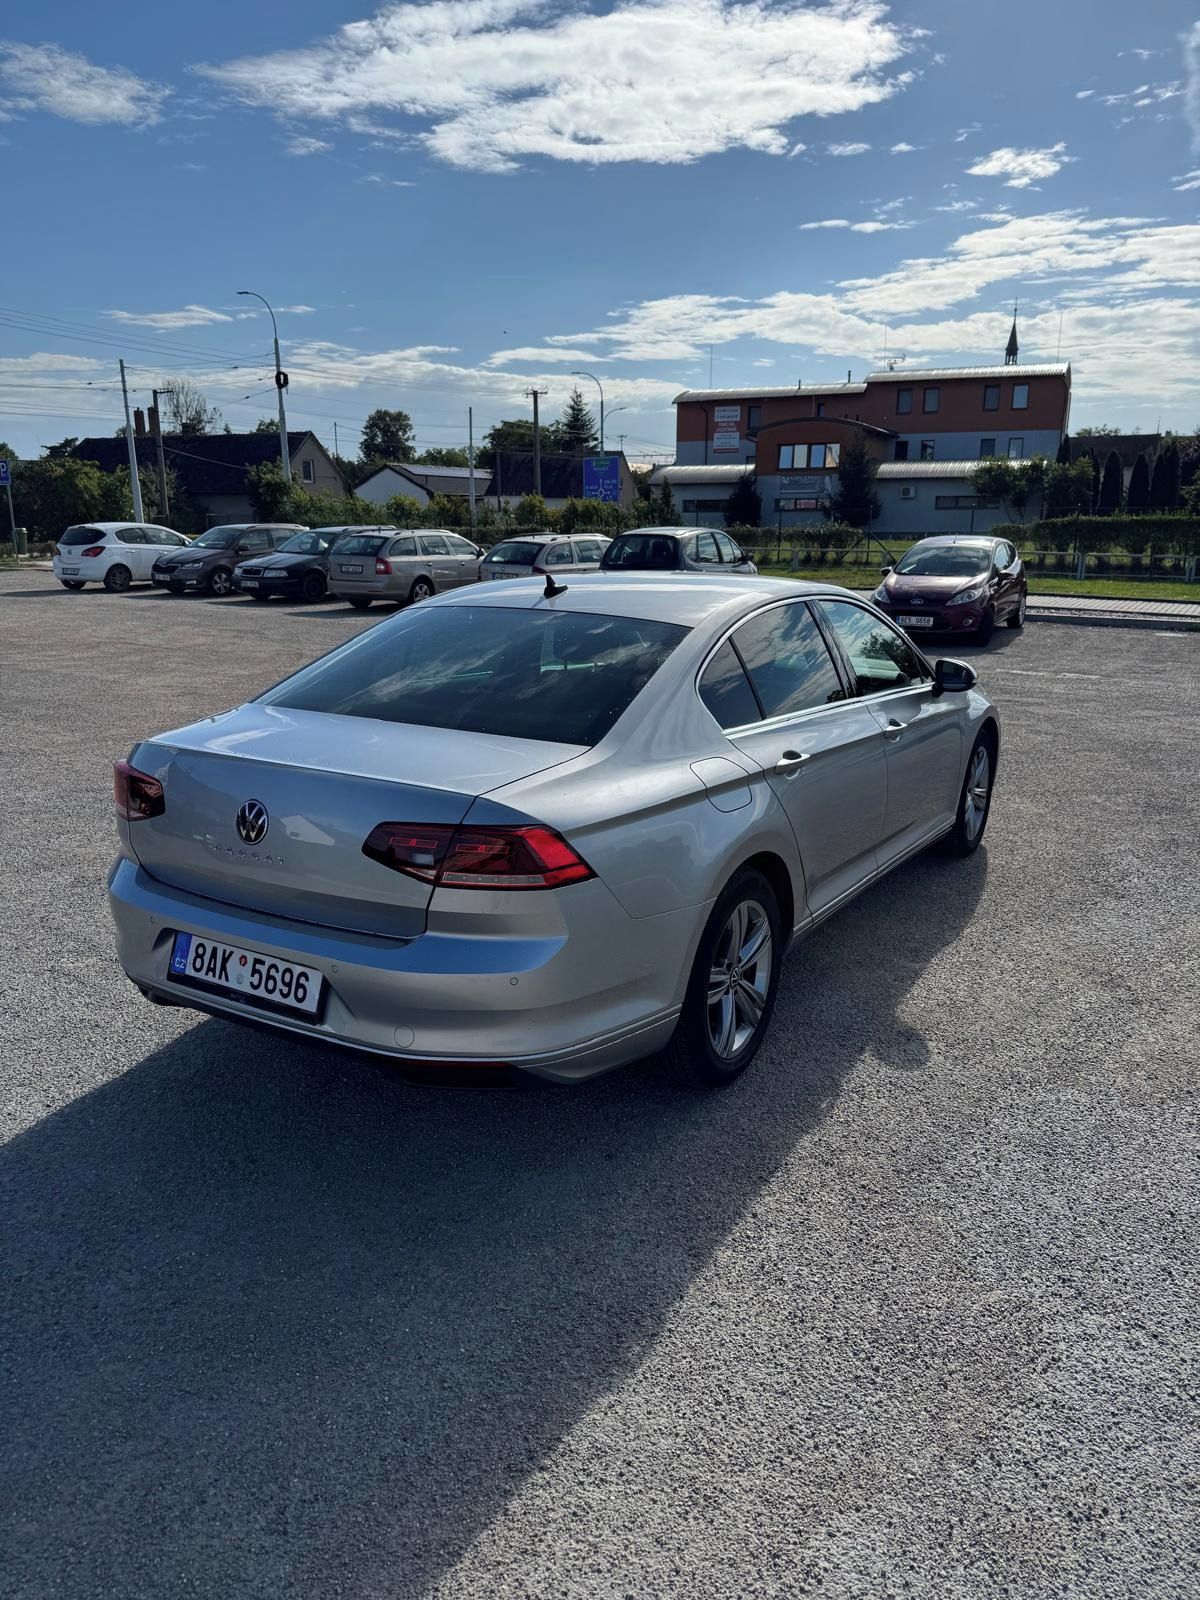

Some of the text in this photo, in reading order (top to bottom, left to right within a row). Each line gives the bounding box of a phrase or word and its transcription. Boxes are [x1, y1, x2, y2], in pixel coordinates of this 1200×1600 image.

[174, 956, 186, 970] CZ
[192, 942, 310, 1004] 8AK 5696
